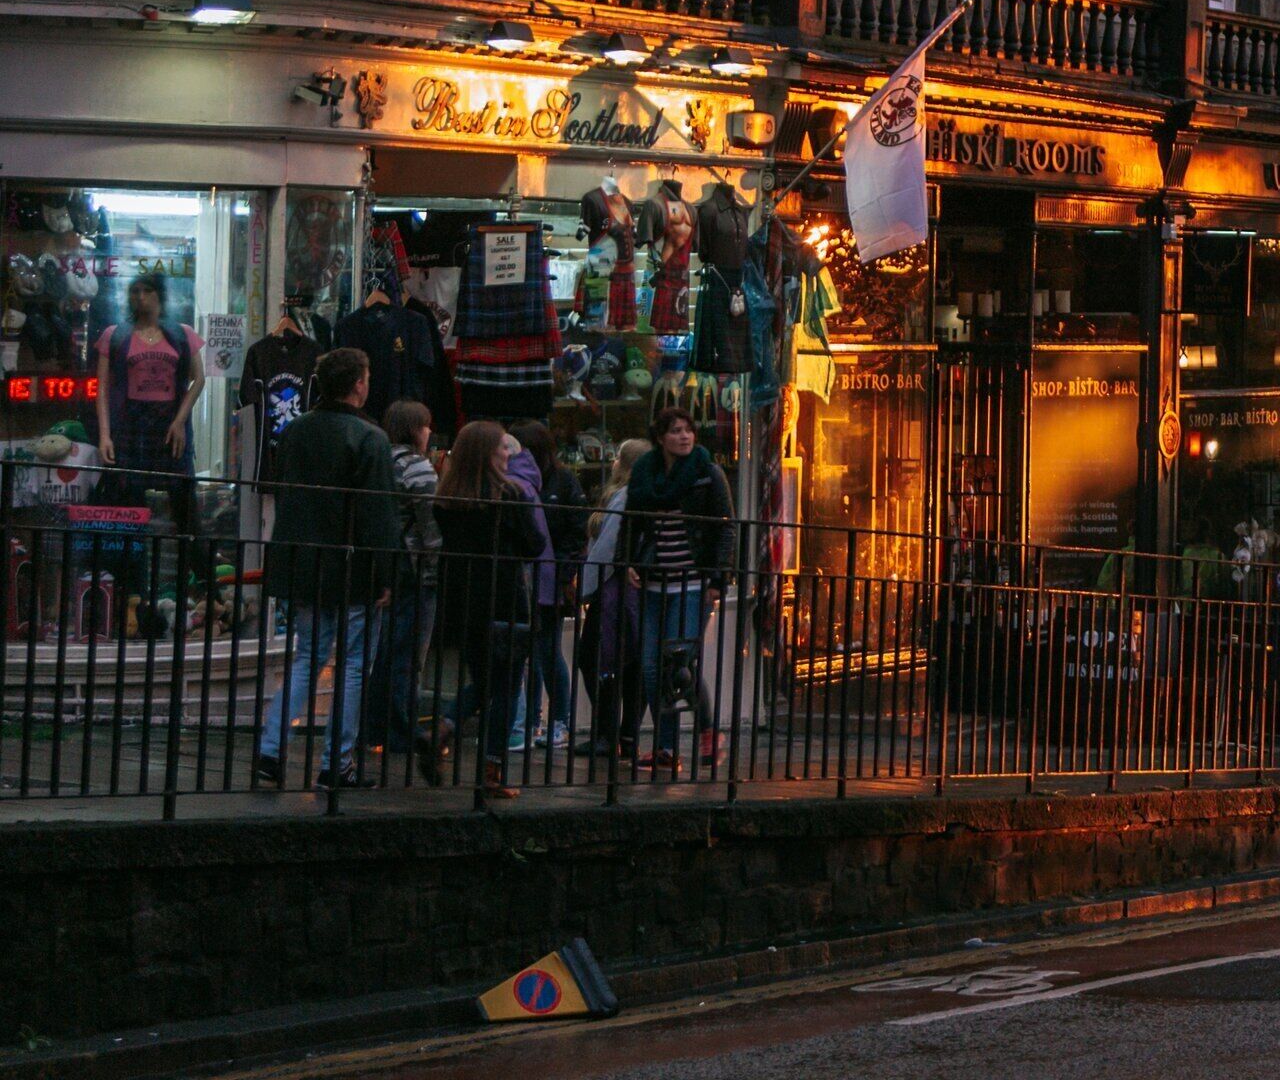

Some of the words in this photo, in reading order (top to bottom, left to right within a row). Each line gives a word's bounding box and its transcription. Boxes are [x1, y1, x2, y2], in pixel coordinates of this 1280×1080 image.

[411, 75, 493, 136] Best
[495, 101, 530, 138] in
[532, 87, 665, 149] Scotland
[1015, 135, 1107, 176] ROOMS
[495, 236, 515, 245] SALE
[208, 317, 243, 328] HENNA
[208, 328, 242, 338] FESTIVAL
[208, 337, 243, 348] OFFERS
[840, 365, 891, 393] BISTRO
[896, 373, 926, 393] BAR
[44, 377, 75, 399] TO
[1031, 380, 1063, 397] SHOP
[1068, 376, 1109, 397] BISTRO
[1114, 380, 1139, 397] BAR
[1188, 413, 1214, 428] SHOP
[1220, 411, 1243, 428] BAR
[1245, 407, 1279, 426] BISTRO
[76, 509, 141, 521] SCOTLAND
[1081, 512, 1118, 521] Scottish
[1080, 524, 1118, 535] hampers
